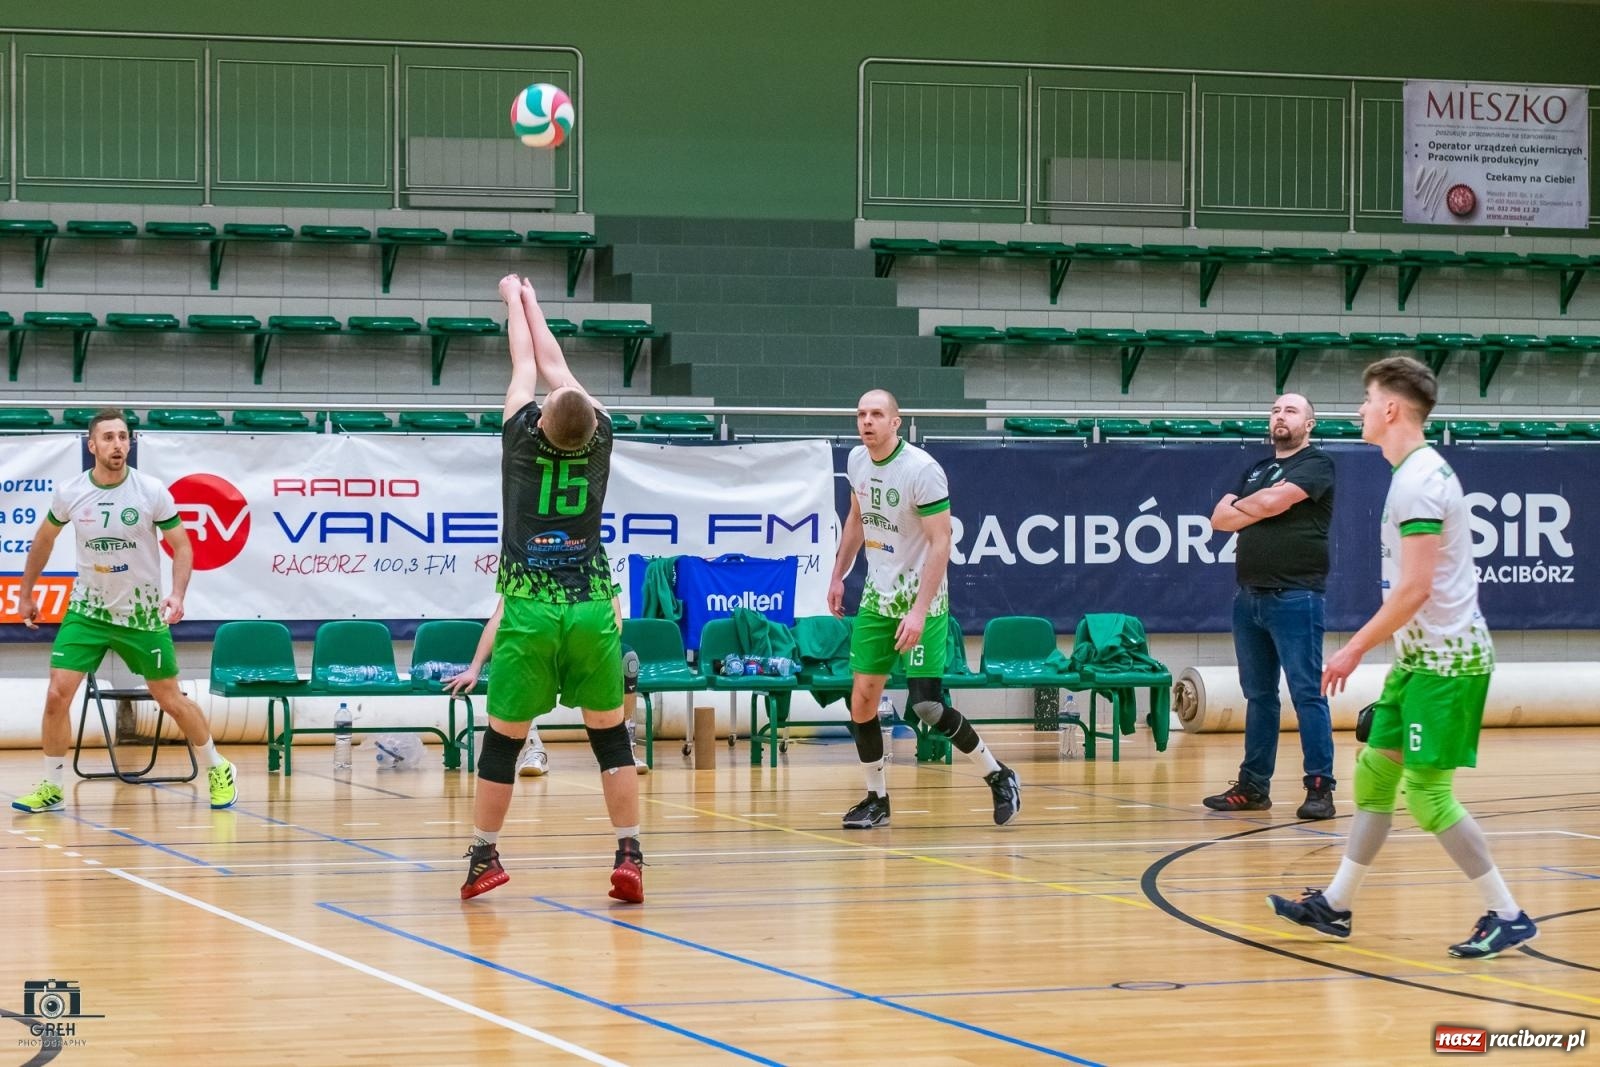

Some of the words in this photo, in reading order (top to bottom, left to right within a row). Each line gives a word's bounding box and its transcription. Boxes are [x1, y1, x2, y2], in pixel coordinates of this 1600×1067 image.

[1426, 89, 1568, 125] MIESZKO
[1428, 141, 1471, 151] Operator
[1474, 143, 1517, 153] urządzeń
[1519, 145, 1583, 156] cukierniczych
[1428, 152, 1479, 163] Pracownik
[1481, 155, 1539, 167] produkcyjny
[1486, 172, 1527, 184] Czekamy
[1530, 175, 1542, 183] na
[1544, 174, 1576, 184] Ciebie!
[0, 479, 53, 493] orzu:
[273, 478, 420, 498] RADIO
[535, 456, 590, 516] 15
[870, 486, 882, 507] 13
[12, 508, 36, 524] 69
[101, 511, 110, 528] 7
[157, 503, 249, 542] RV
[707, 513, 820, 545] FM
[373, 557, 419, 575] 100,3
[423, 555, 457, 576] FM
[474, 554, 499, 576] KR
[1473, 560, 1575, 583] RACIBÓRZ
[706, 591, 784, 613] molten
[910, 644, 925, 667] 13
[1408, 722, 1423, 752] 6
